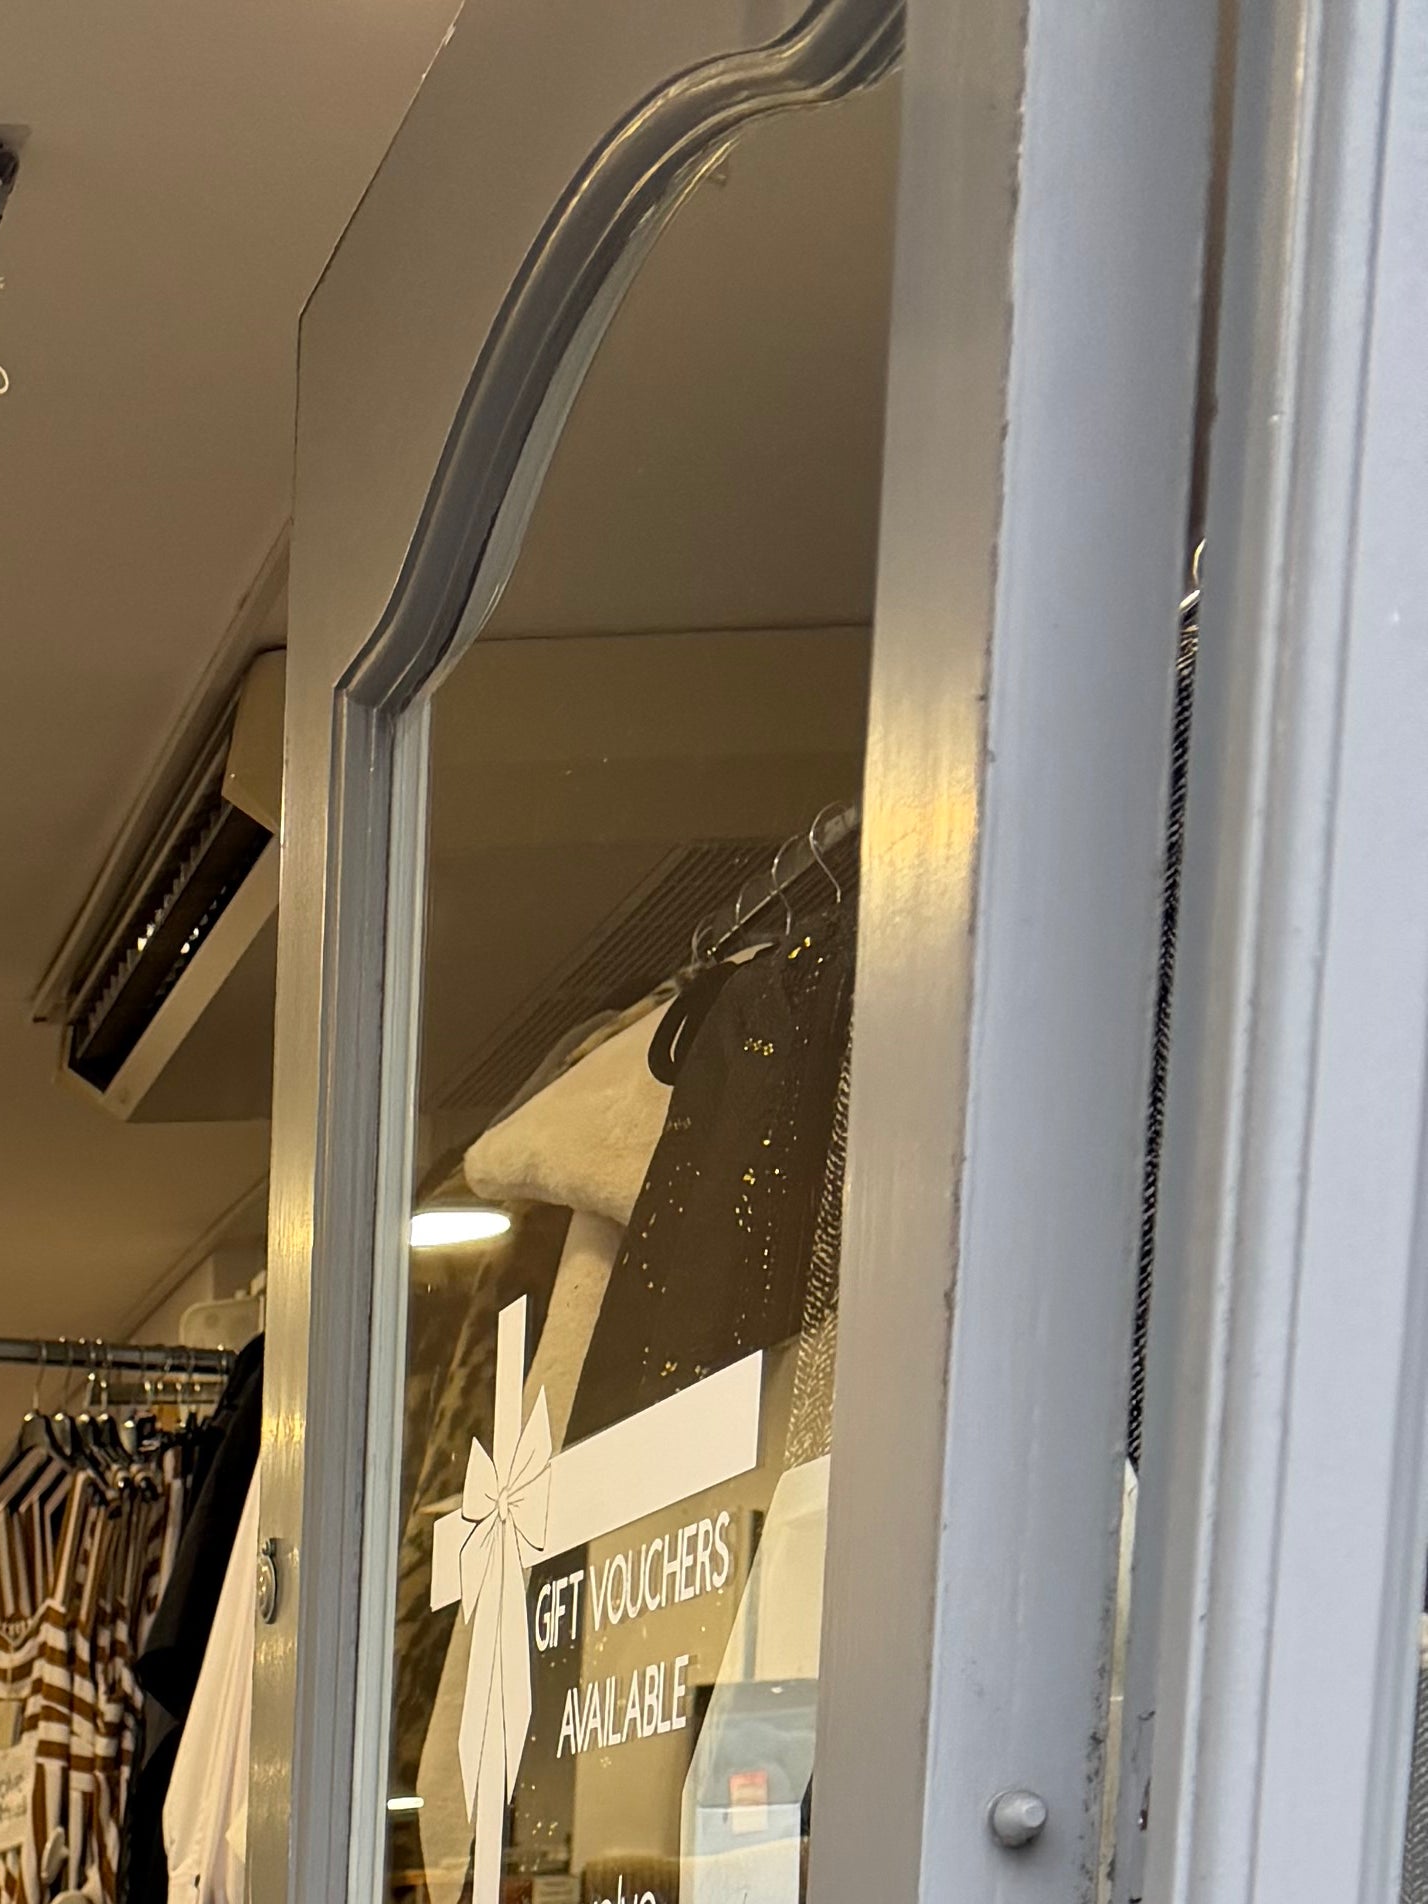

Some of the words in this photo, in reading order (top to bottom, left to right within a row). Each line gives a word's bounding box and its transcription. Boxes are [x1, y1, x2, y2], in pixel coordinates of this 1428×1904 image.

[535, 1569, 584, 1652] GIFT
[590, 1511, 730, 1632] VOUCHERS
[557, 1654, 690, 1759] AVAILABLE
